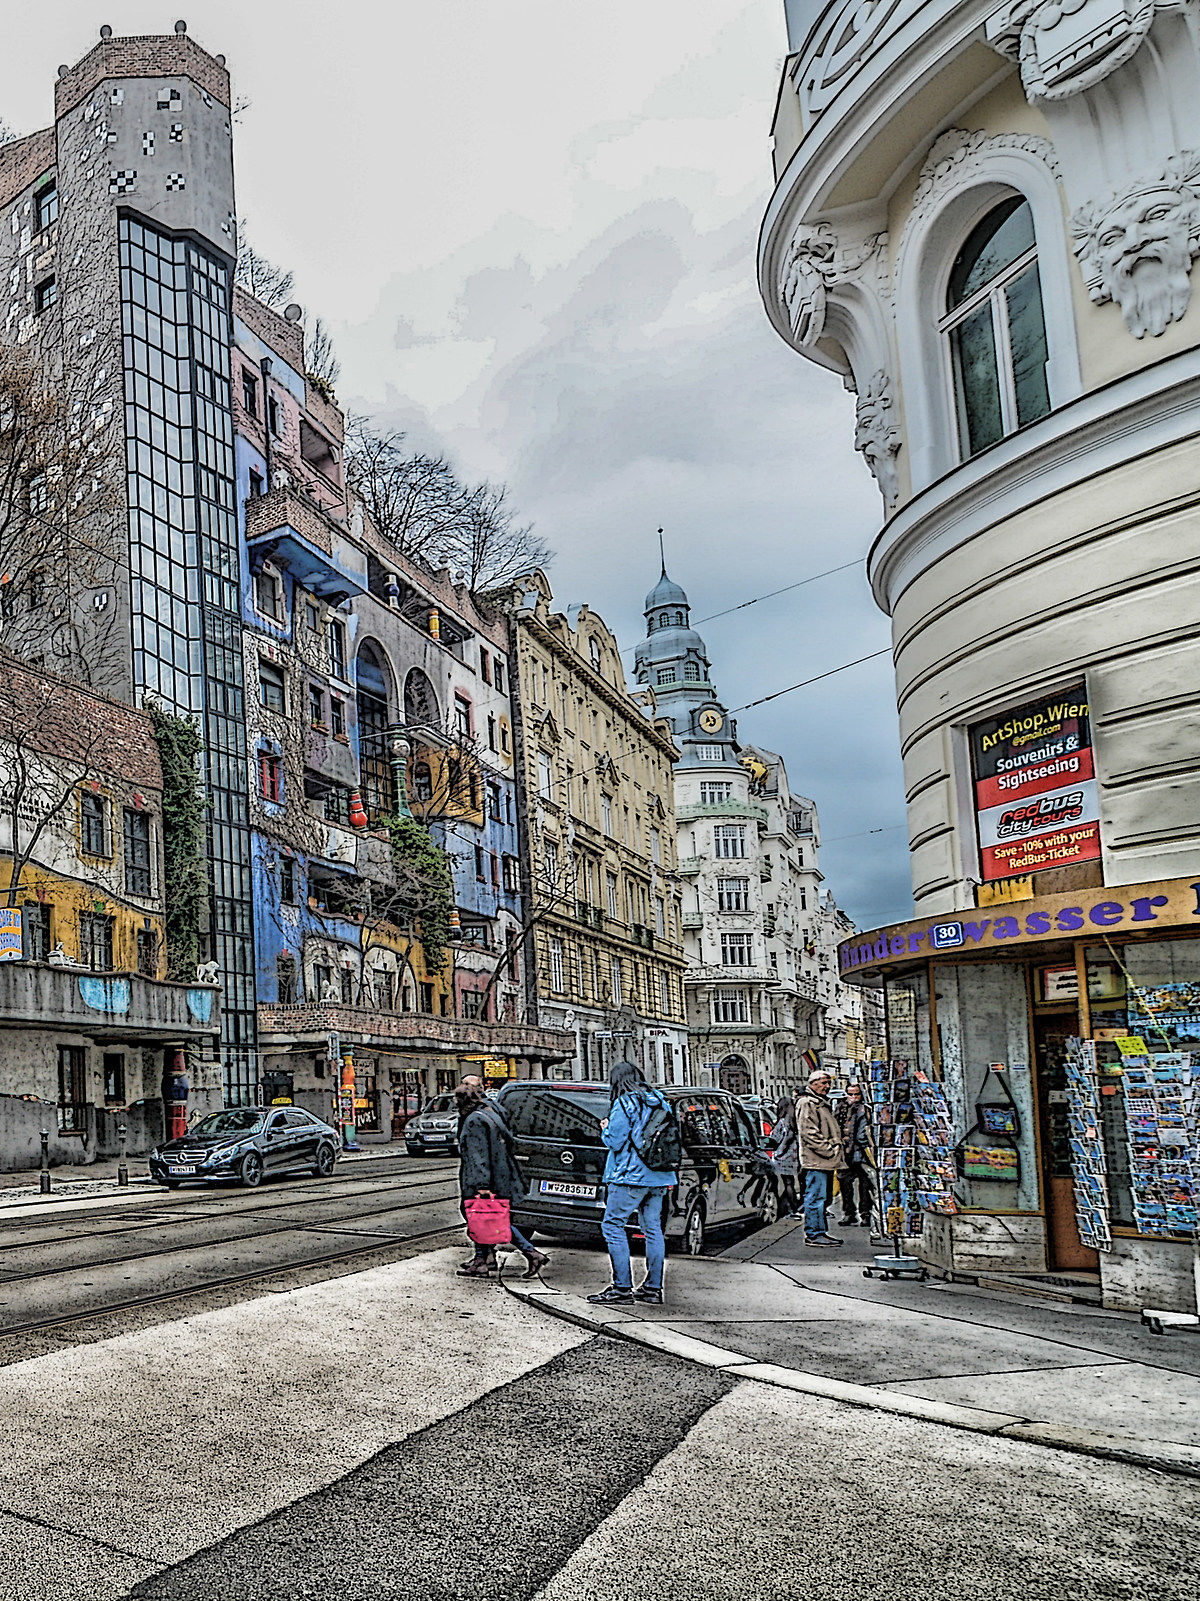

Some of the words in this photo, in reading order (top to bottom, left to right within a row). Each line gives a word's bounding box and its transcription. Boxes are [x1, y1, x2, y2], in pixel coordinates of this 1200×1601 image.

[982, 703, 1089, 751] ArtShop.Wien
[1012, 724, 1061, 746] @gmail.com
[996, 743, 1064, 772] Souvenirs
[1065, 736, 1079, 751] &
[998, 757, 1079, 790] Sightseeing
[1001, 793, 1083, 824] redbus
[994, 848, 1018, 859] Save
[1018, 839, 1044, 853] -10%
[1044, 835, 1068, 848] with
[1070, 828, 1096, 841] your
[1009, 845, 1080, 868] RedBus-Ticket
[939, 926, 956, 939] 30
[649, 1029, 669, 1037] BIPA
